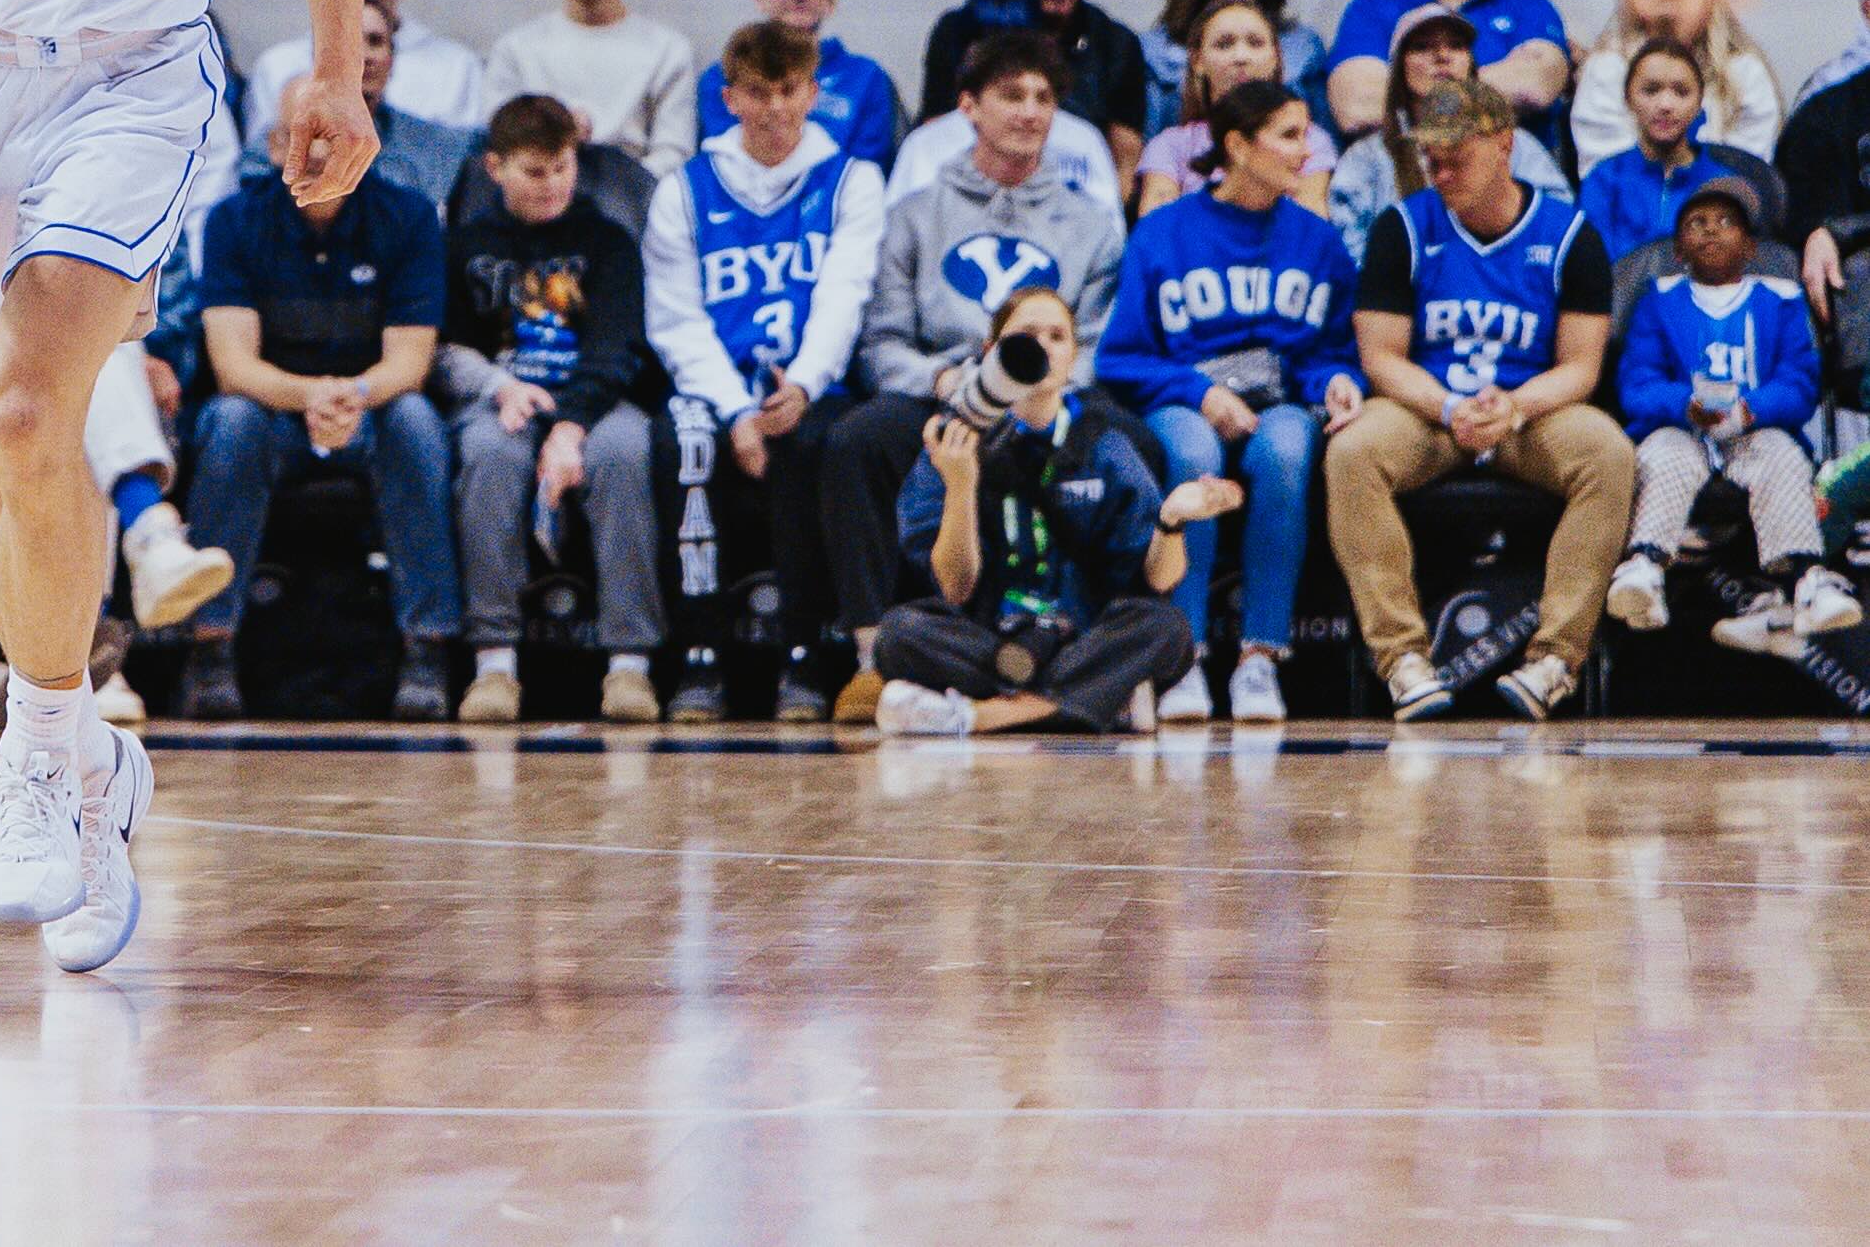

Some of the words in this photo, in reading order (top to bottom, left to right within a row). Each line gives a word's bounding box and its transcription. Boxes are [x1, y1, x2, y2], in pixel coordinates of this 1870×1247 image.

[702, 231, 828, 305] BYU
[957, 236, 1051, 312] Y
[752, 300, 794, 365] 3
